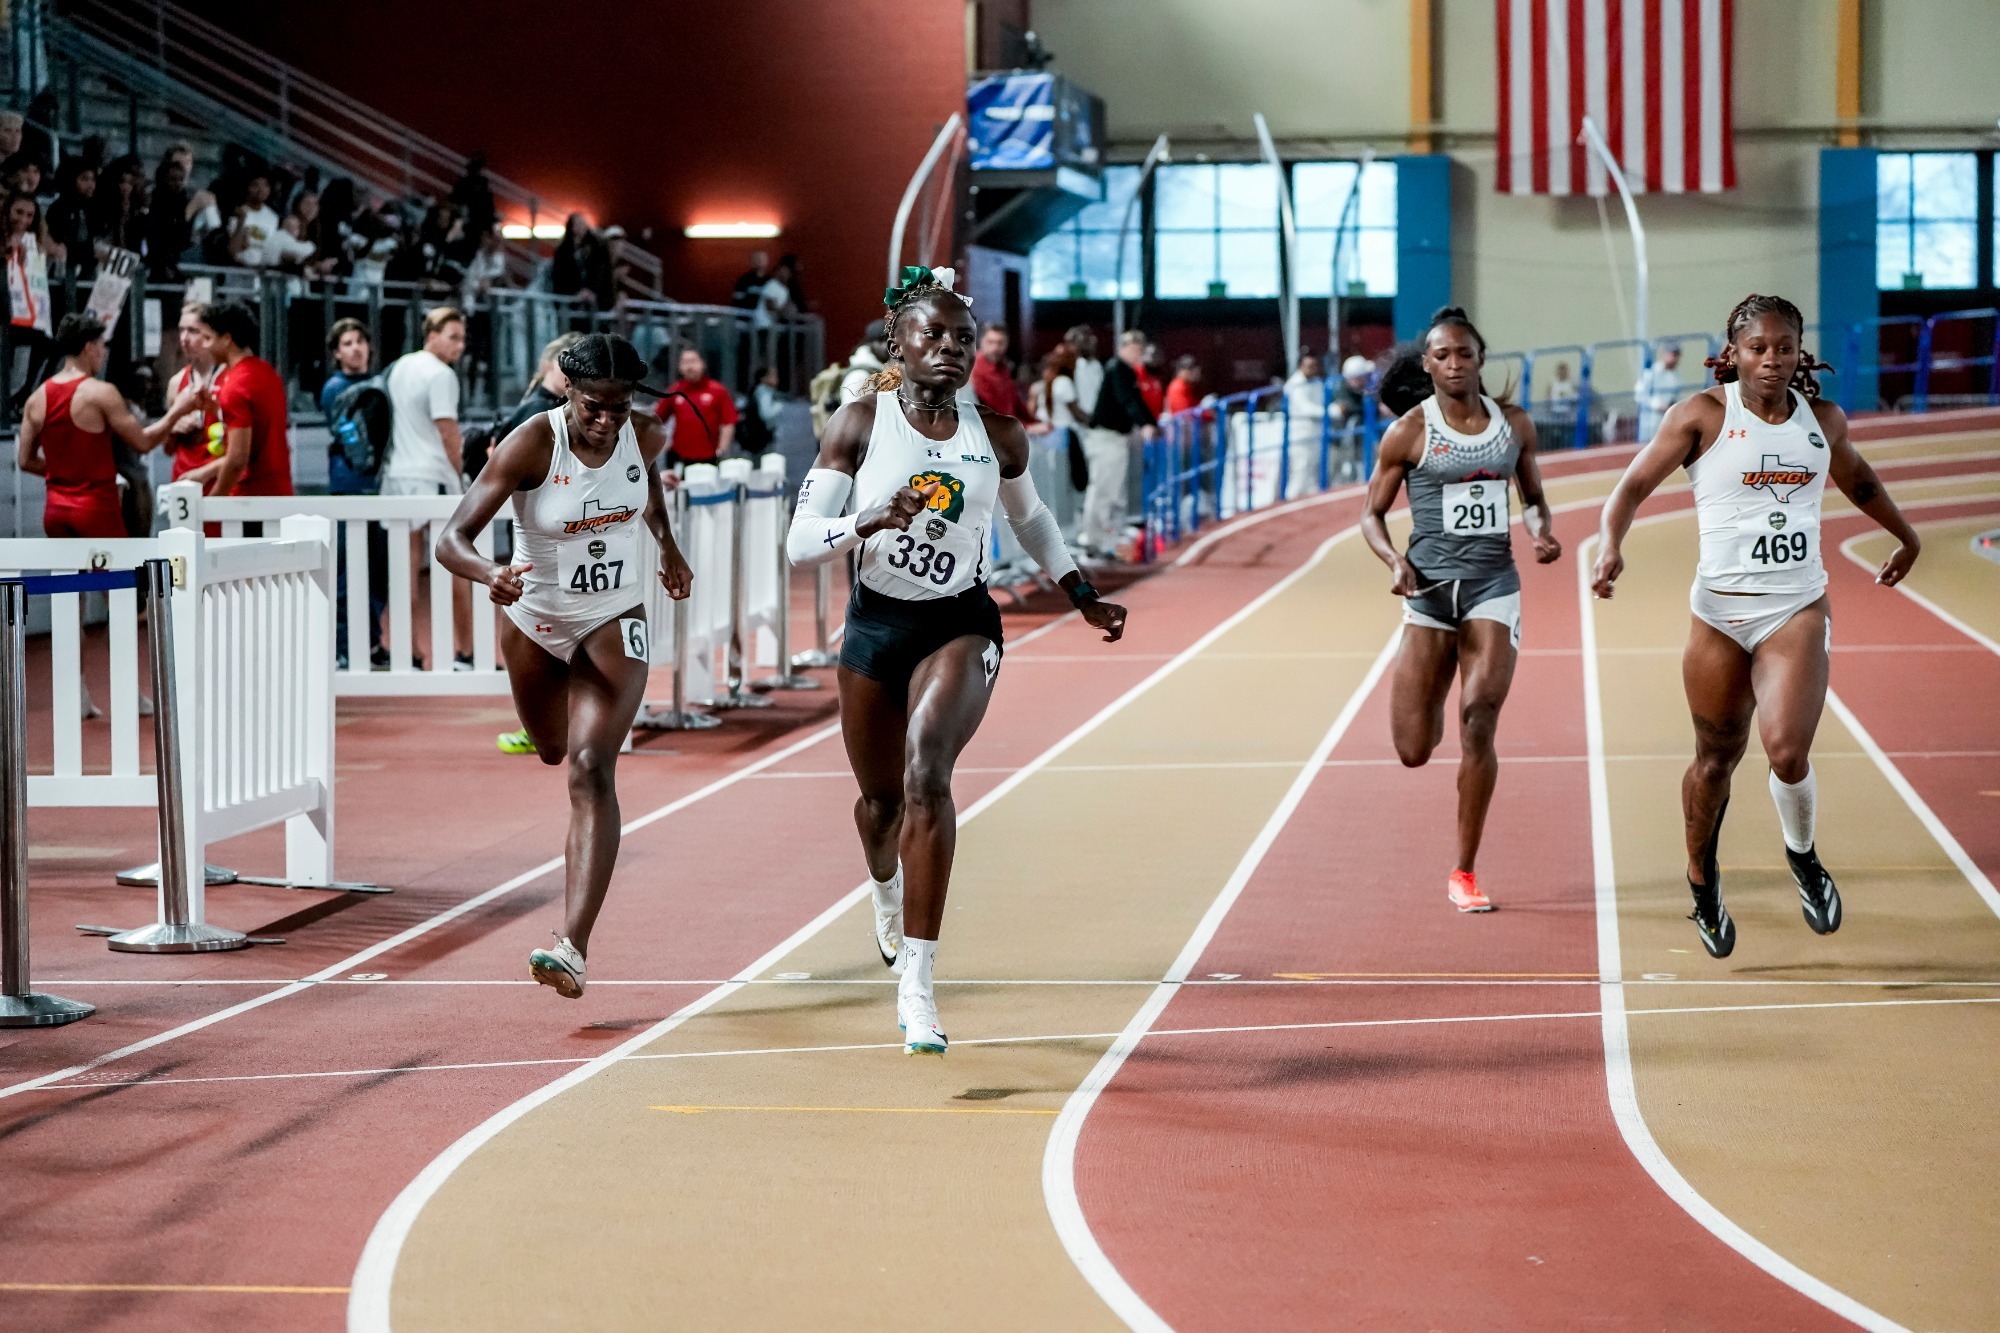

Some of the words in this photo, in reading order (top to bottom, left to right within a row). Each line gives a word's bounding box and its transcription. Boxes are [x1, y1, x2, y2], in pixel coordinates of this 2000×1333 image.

[960, 454, 991, 464] SLC
[1741, 471, 1818, 486] UTRGV
[176, 496, 189, 521] 3
[1453, 502, 1496, 530] 291
[887, 534, 956, 586] 339
[1751, 531, 1808, 565] 469
[570, 559, 624, 593] 467
[628, 620, 645, 658] 6
